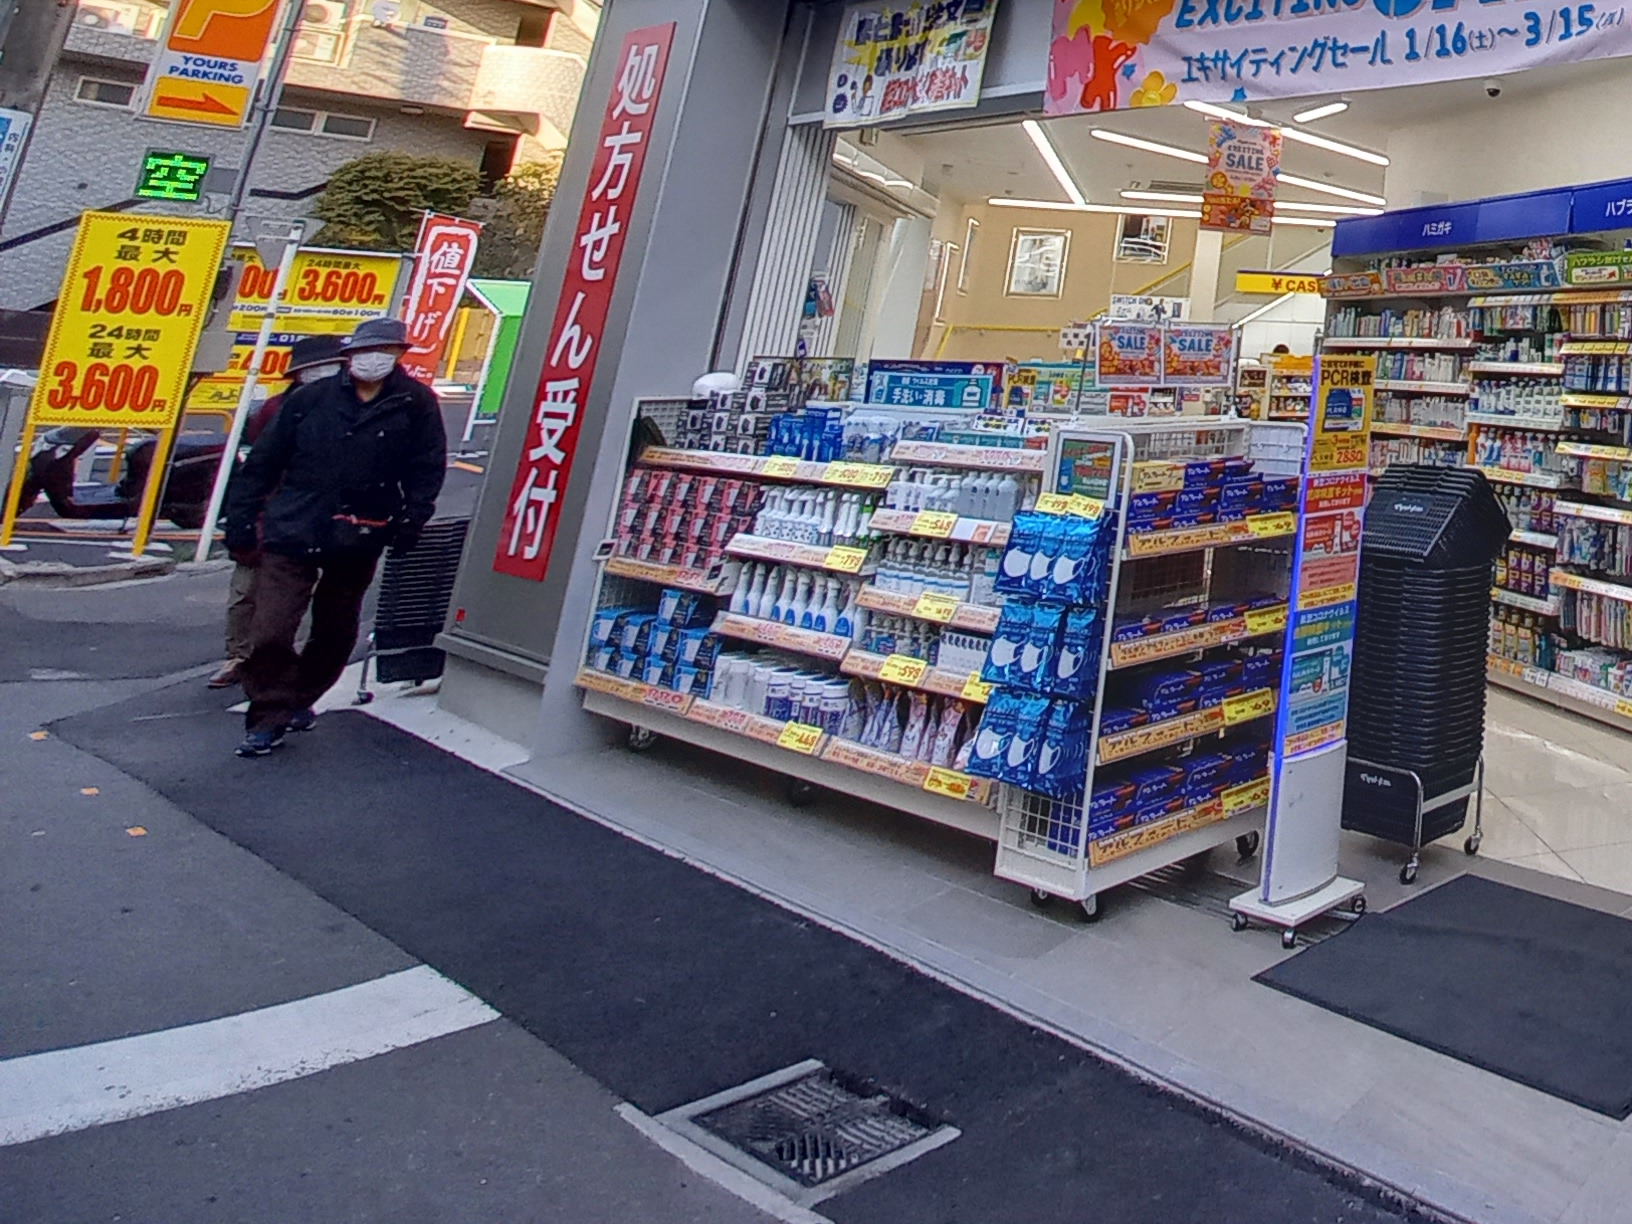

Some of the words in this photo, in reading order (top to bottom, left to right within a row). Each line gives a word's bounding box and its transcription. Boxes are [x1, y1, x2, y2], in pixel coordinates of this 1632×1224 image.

[182, 55, 238, 73] YOURS
[1181, 30, 1392, 85] エキサイティングセール
[168, 65, 244, 85] PARKING
[1225, 153, 1264, 171] SALE
[138, 154, 208, 201] 空
[116, 227, 189, 246] 4時間
[1421, 222, 1452, 236] ハミガキ
[115, 244, 180, 264] 最大
[81, 265, 194, 317] 1,800円
[299, 268, 385, 305] 3,600円
[411, 240, 463, 343] 値下げ
[1285, 280, 1319, 293] CAS
[507, 41, 657, 559] 処方せん受付
[88, 323, 161, 342] 24時間
[87, 342, 152, 360] 最大
[1117, 335, 1147, 350] SALE
[1177, 337, 1214, 353] SALE
[48, 360, 168, 413] 3,600円
[1320, 368, 1373, 386] PCR検査
